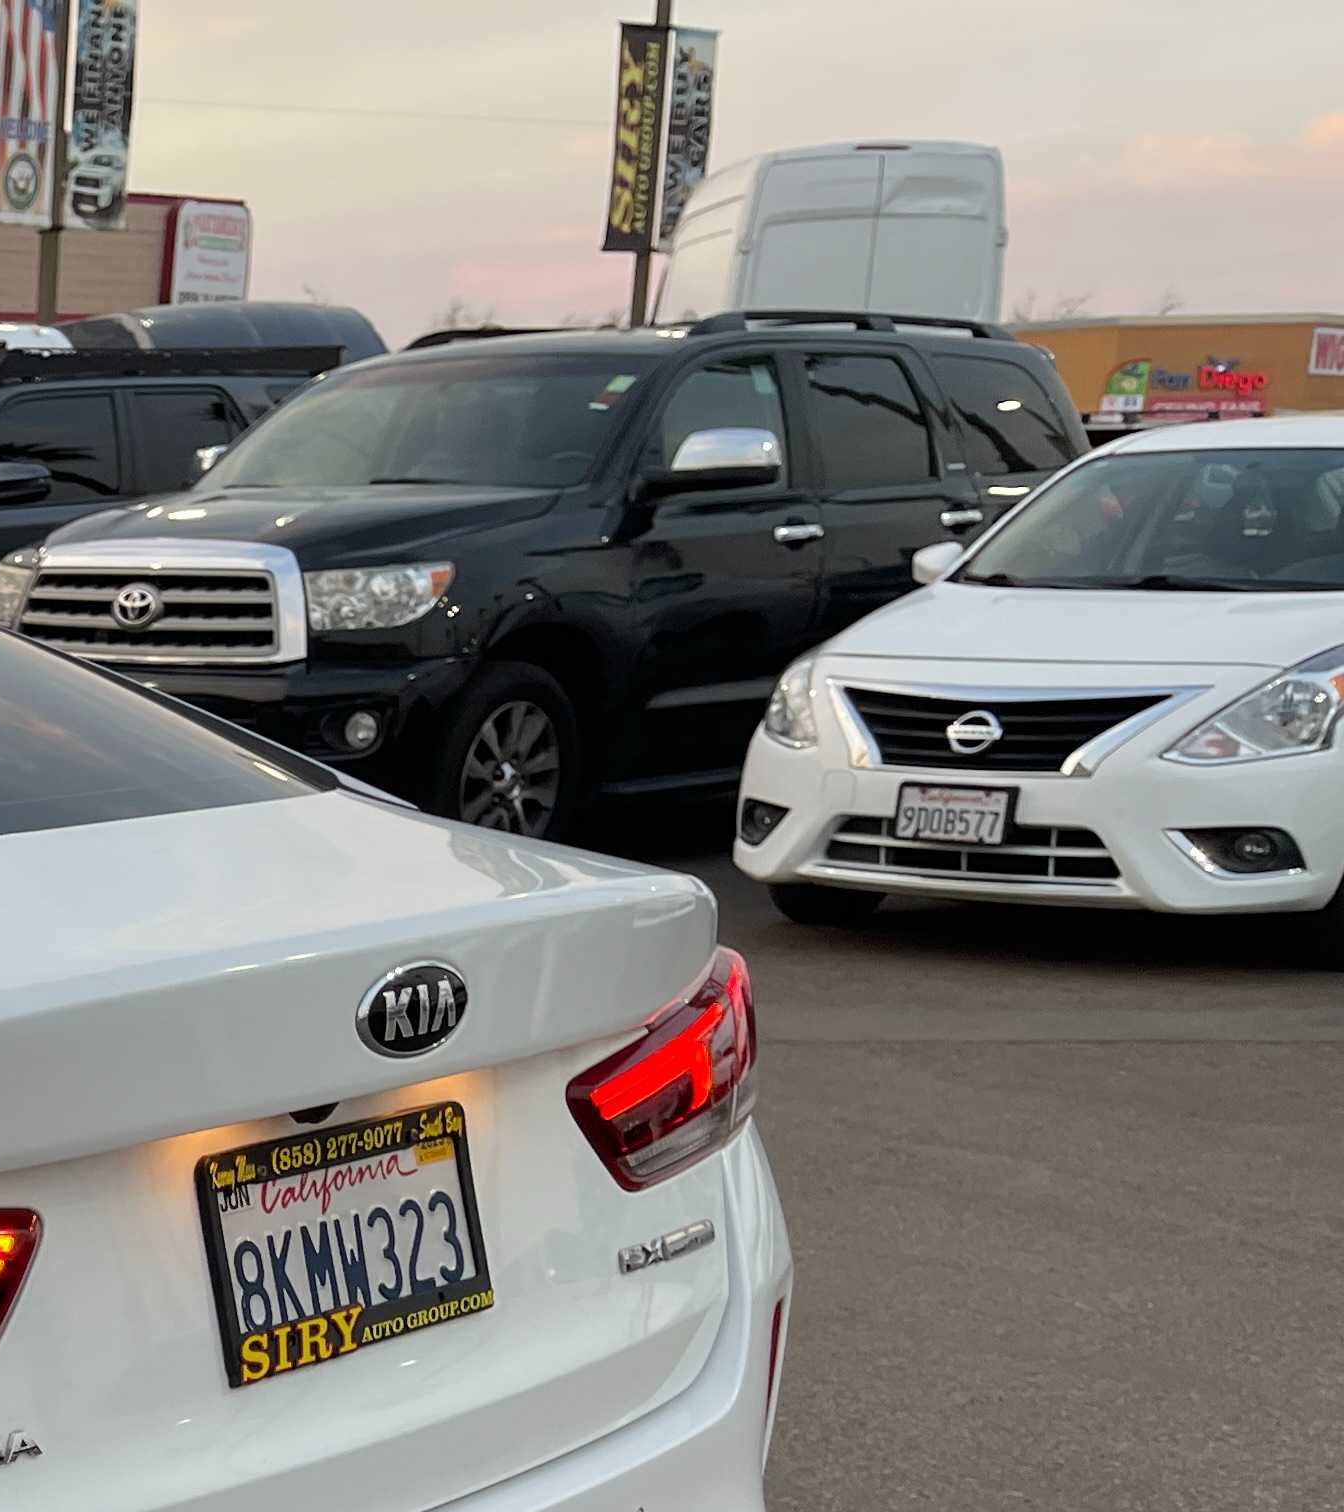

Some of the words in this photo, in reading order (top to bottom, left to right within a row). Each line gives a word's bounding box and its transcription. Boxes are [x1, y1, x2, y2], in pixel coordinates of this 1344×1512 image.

[85, 2, 103, 99] FINAN
[674, 46, 691, 125] BUY
[80, 111, 98, 151] WE
[610, 39, 644, 234] SIRY
[687, 70, 710, 168] CARS
[666, 135, 689, 190] WE
[632, 174, 650, 234] AUTO
[382, 976, 457, 1042] KIA
[272, 1138, 322, 1175] (858)
[326, 1121, 403, 1160] 277-9077
[260, 1153, 418, 1216] California
[233, 1190, 466, 1333] 8KMW323
[240, 1304, 364, 1384] SIRY
[362, 1317, 405, 1344] AUTO
[406, 1289, 496, 1330] GROUP.COM
